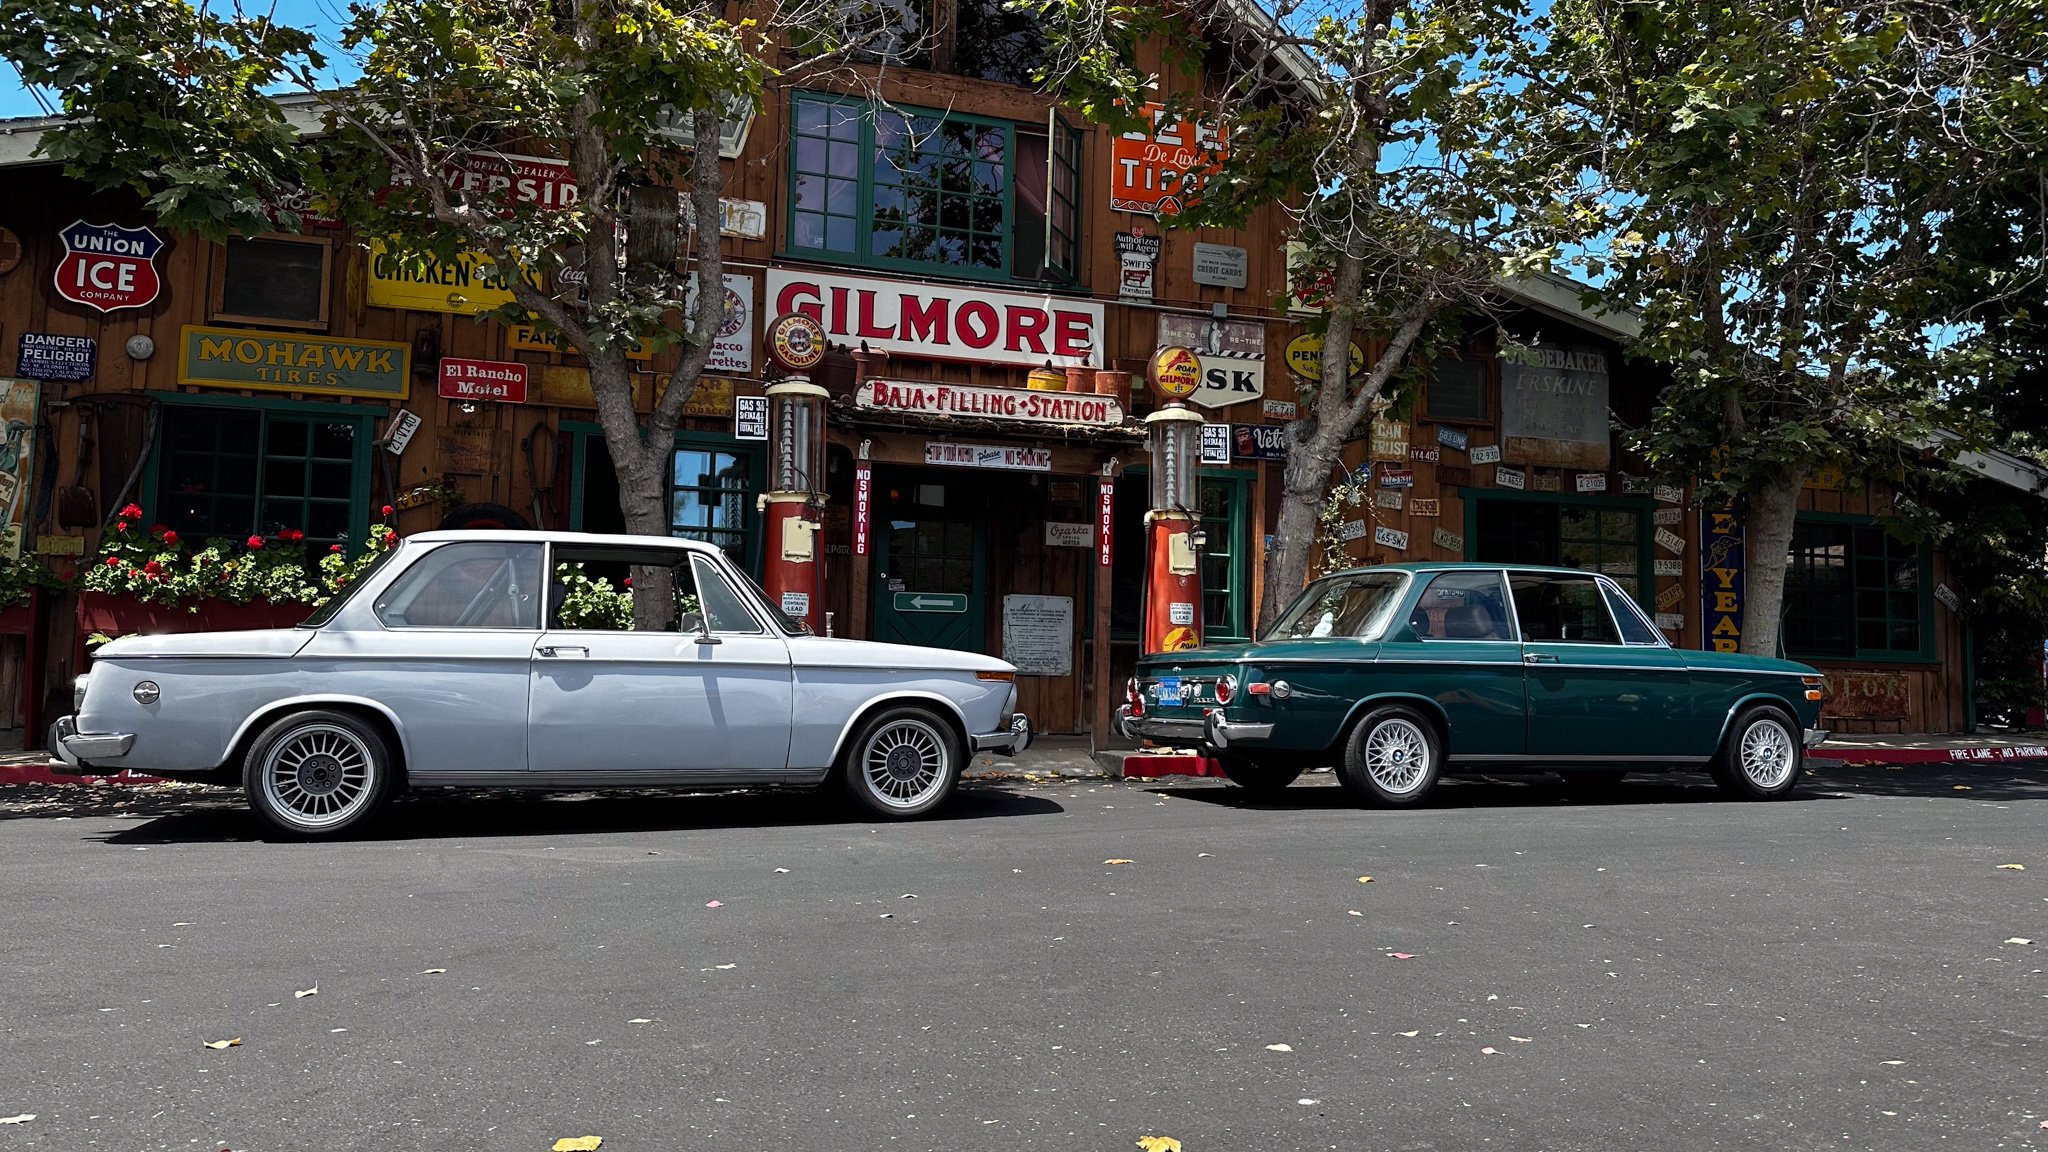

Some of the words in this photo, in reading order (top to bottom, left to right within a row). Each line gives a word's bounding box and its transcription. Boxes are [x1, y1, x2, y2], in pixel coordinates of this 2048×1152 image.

[1122, 109, 1223, 151] EE
[1143, 144, 1167, 162] De
[516, 166, 556, 178] DEALER
[1120, 158, 1210, 195] Tire
[390, 162, 578, 206] RVERSID
[103, 229, 119, 238] THE
[1116, 234, 1159, 247] Authorized
[74, 234, 144, 255] UNION
[1118, 242, 1134, 250] wift
[1136, 243, 1159, 253] Agent
[374, 253, 470, 287] CIKEN
[1123, 259, 1152, 270] SWIFT'S
[1197, 264, 1219, 275] CREDIT
[1221, 266, 1243, 277] CARDS
[76, 258, 137, 292] ICE
[80, 290, 130, 302] COMPANY
[776, 281, 1094, 357] GILMORE
[778, 318, 821, 338] GILMORE
[1162, 329, 1181, 338] TIME
[1186, 331, 1196, 339] TO
[25, 333, 91, 349] DANGER!
[711, 341, 744, 352] acco
[1229, 336, 1262, 346] RE-TIRE
[24, 348, 90, 363] PELIGRO!
[198, 335, 397, 374] MOHAWK
[779, 344, 821, 364] GASOLINE
[1505, 349, 1608, 374] STDEBAKER
[707, 357, 748, 369] rettes
[1175, 364, 1197, 374] ROAR
[256, 367, 338, 386] TIRES
[445, 364, 462, 377] El
[466, 365, 522, 383] Rancho
[1160, 374, 1196, 386] GILMORE
[1199, 368, 1258, 393] SK
[456, 381, 509, 397] Motel
[1516, 373, 1598, 396] ERSKINE
[740, 400, 754, 411] GAS
[873, 381, 926, 410] BAJA
[937, 387, 1017, 415] FILLING
[1027, 394, 1107, 422] STATION
[740, 424, 754, 432] TOTAL
[1204, 427, 1216, 438] GAS
[1378, 423, 1401, 438] CAN
[1253, 428, 1286, 449] Vel
[929, 445, 942, 461] STOP
[943, 446, 956, 462] YOUR
[957, 447, 974, 463] MOTOR
[978, 449, 1001, 466] please
[1005, 450, 1015, 465] NO
[1016, 450, 1048, 467] SMOKING
[1204, 450, 1217, 458] TOTAL
[1372, 441, 1409, 456] TRUST
[1425, 450, 1440, 461] 403
[857, 469, 871, 480] NO
[1101, 484, 1113, 494] NO
[857, 480, 867, 554] SMOKING
[1050, 524, 1089, 537] Ozarka
[1102, 494, 1111, 564] SMOKING
[1820, 675, 1899, 699] NLOP
[1949, 749, 1970, 760] FIRE
[1970, 748, 1994, 759] LANE
[2002, 748, 2014, 758] NO
[2014, 746, 2048, 757] PARKING
